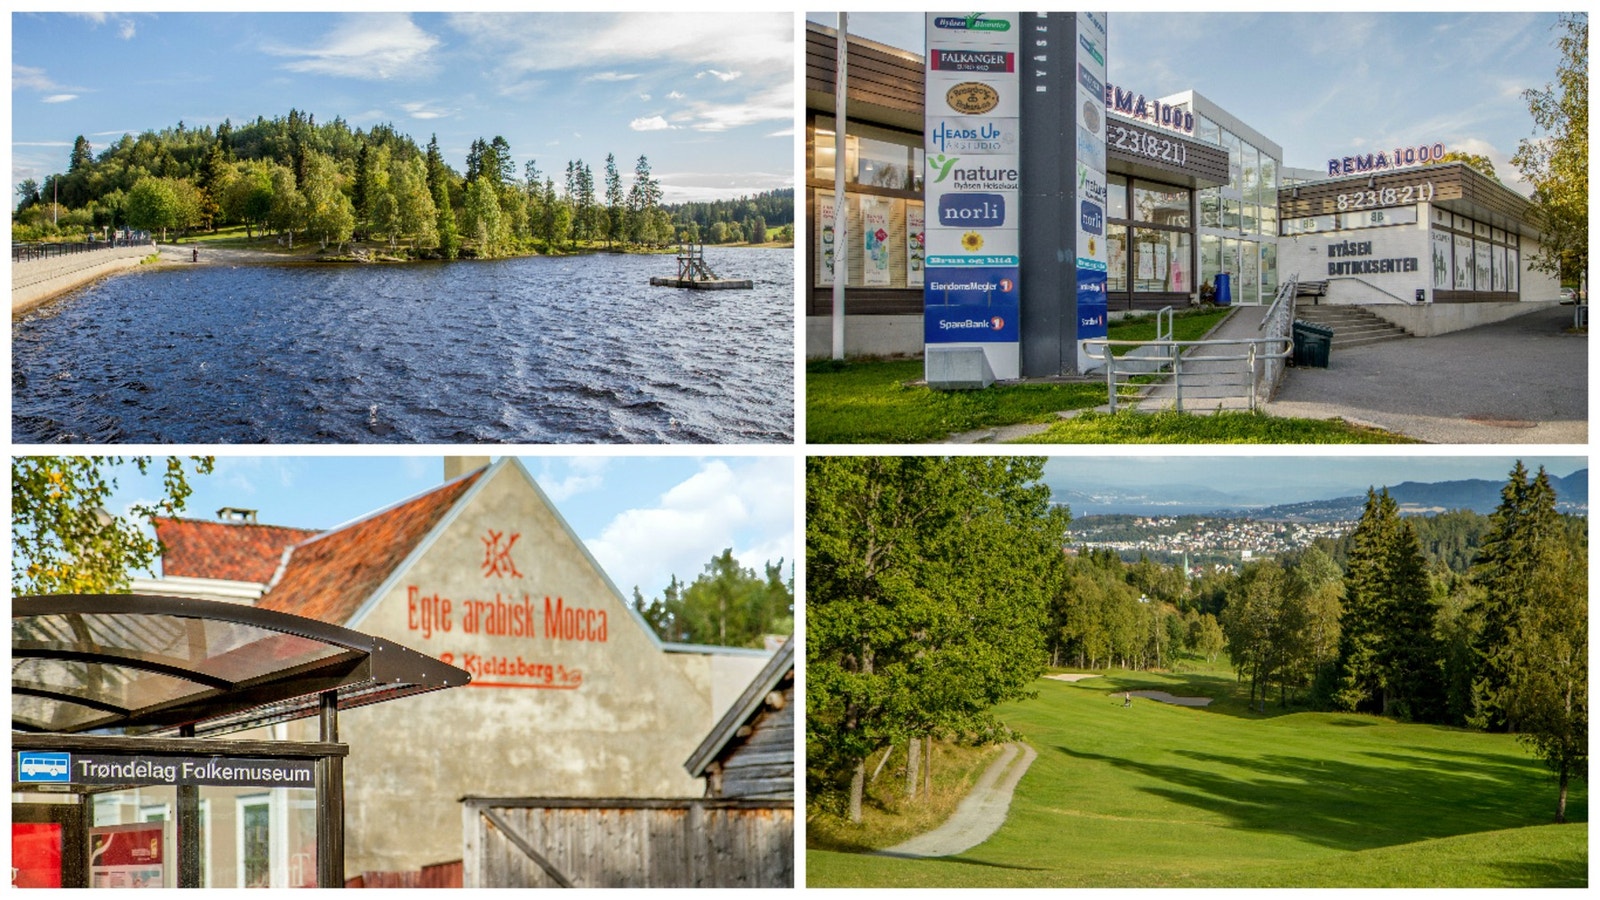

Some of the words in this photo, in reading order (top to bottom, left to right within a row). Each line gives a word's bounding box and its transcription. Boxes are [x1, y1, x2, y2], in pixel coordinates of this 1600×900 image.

[941, 53, 1005, 64] FALKANGER
[1153, 100, 1195, 133] 1000
[1327, 151, 1389, 177] REMA
[1394, 143, 1446, 167] 1000
[954, 166, 1018, 181] nature
[944, 202, 999, 219] norli
[1327, 240, 1372, 258] BYÅSEN
[1327, 257, 1418, 276] BUTIKKSENTER
[930, 281, 998, 293] EiendomsMegler
[939, 319, 990, 330] SpareBank
[407, 585, 453, 640] Egte
[462, 592, 536, 639] arabisk
[543, 596, 609, 643] Mocca
[462, 653, 553, 684] Kjeldsberg
[78, 759, 176, 782] Trøndelag
[182, 761, 311, 782] Folkemuseum
